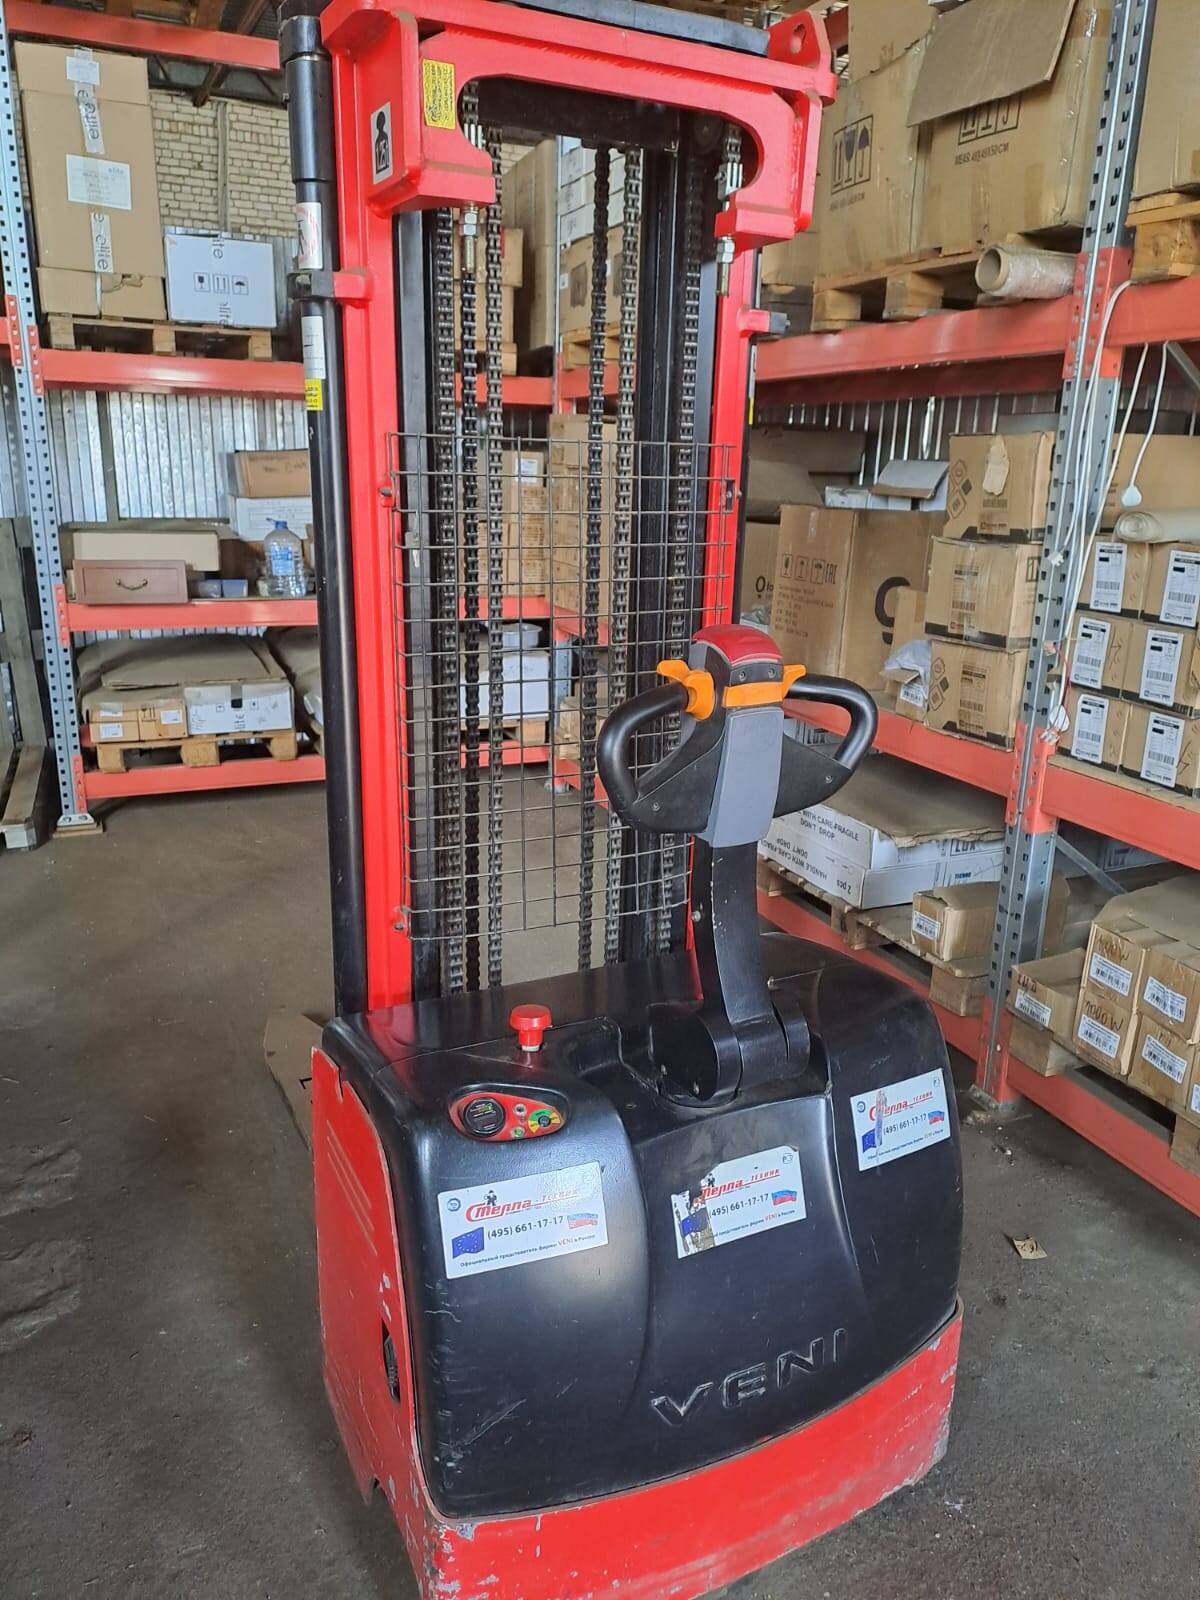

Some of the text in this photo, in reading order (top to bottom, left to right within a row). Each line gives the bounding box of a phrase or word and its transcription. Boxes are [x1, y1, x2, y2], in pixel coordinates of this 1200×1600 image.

[818, 827, 836, 841] DROP
[847, 885, 853, 896] 2
[899, 1113, 927, 1130] 661-17-17
[730, 1193, 769, 1212] 661-17-17
[487, 1216, 564, 1242] (495) 661-17-17
[558, 1237, 574, 1248] VENI
[650, 1327, 848, 1428] VENI
